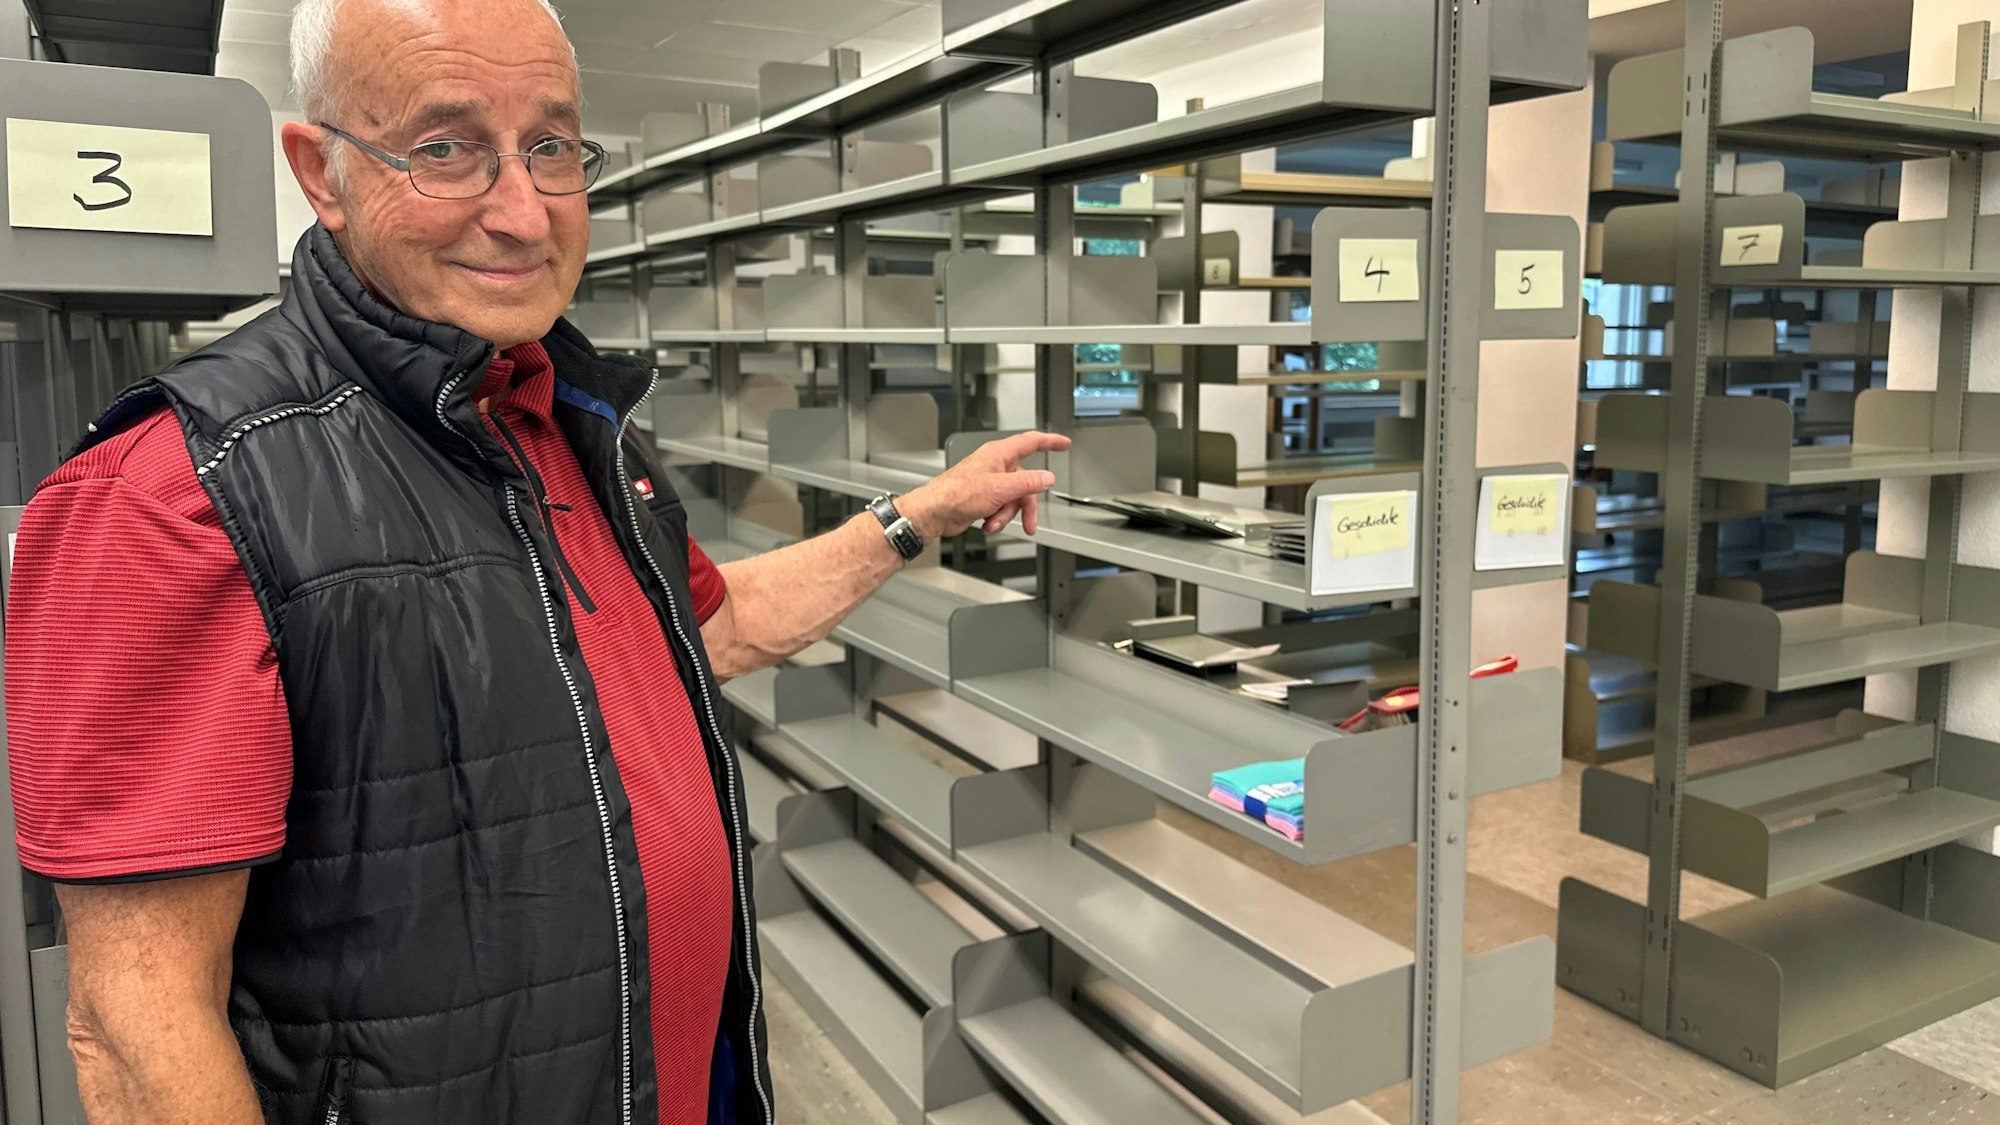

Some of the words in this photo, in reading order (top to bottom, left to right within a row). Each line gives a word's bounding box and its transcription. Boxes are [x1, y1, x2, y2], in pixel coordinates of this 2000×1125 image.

[73, 149, 133, 211] 3
[1737, 233, 1760, 262] 7
[1364, 255, 1390, 294] 4
[1518, 263, 1535, 295] 5
[1497, 491, 1546, 511] Geschichte
[1337, 506, 1399, 534] Geschichte
